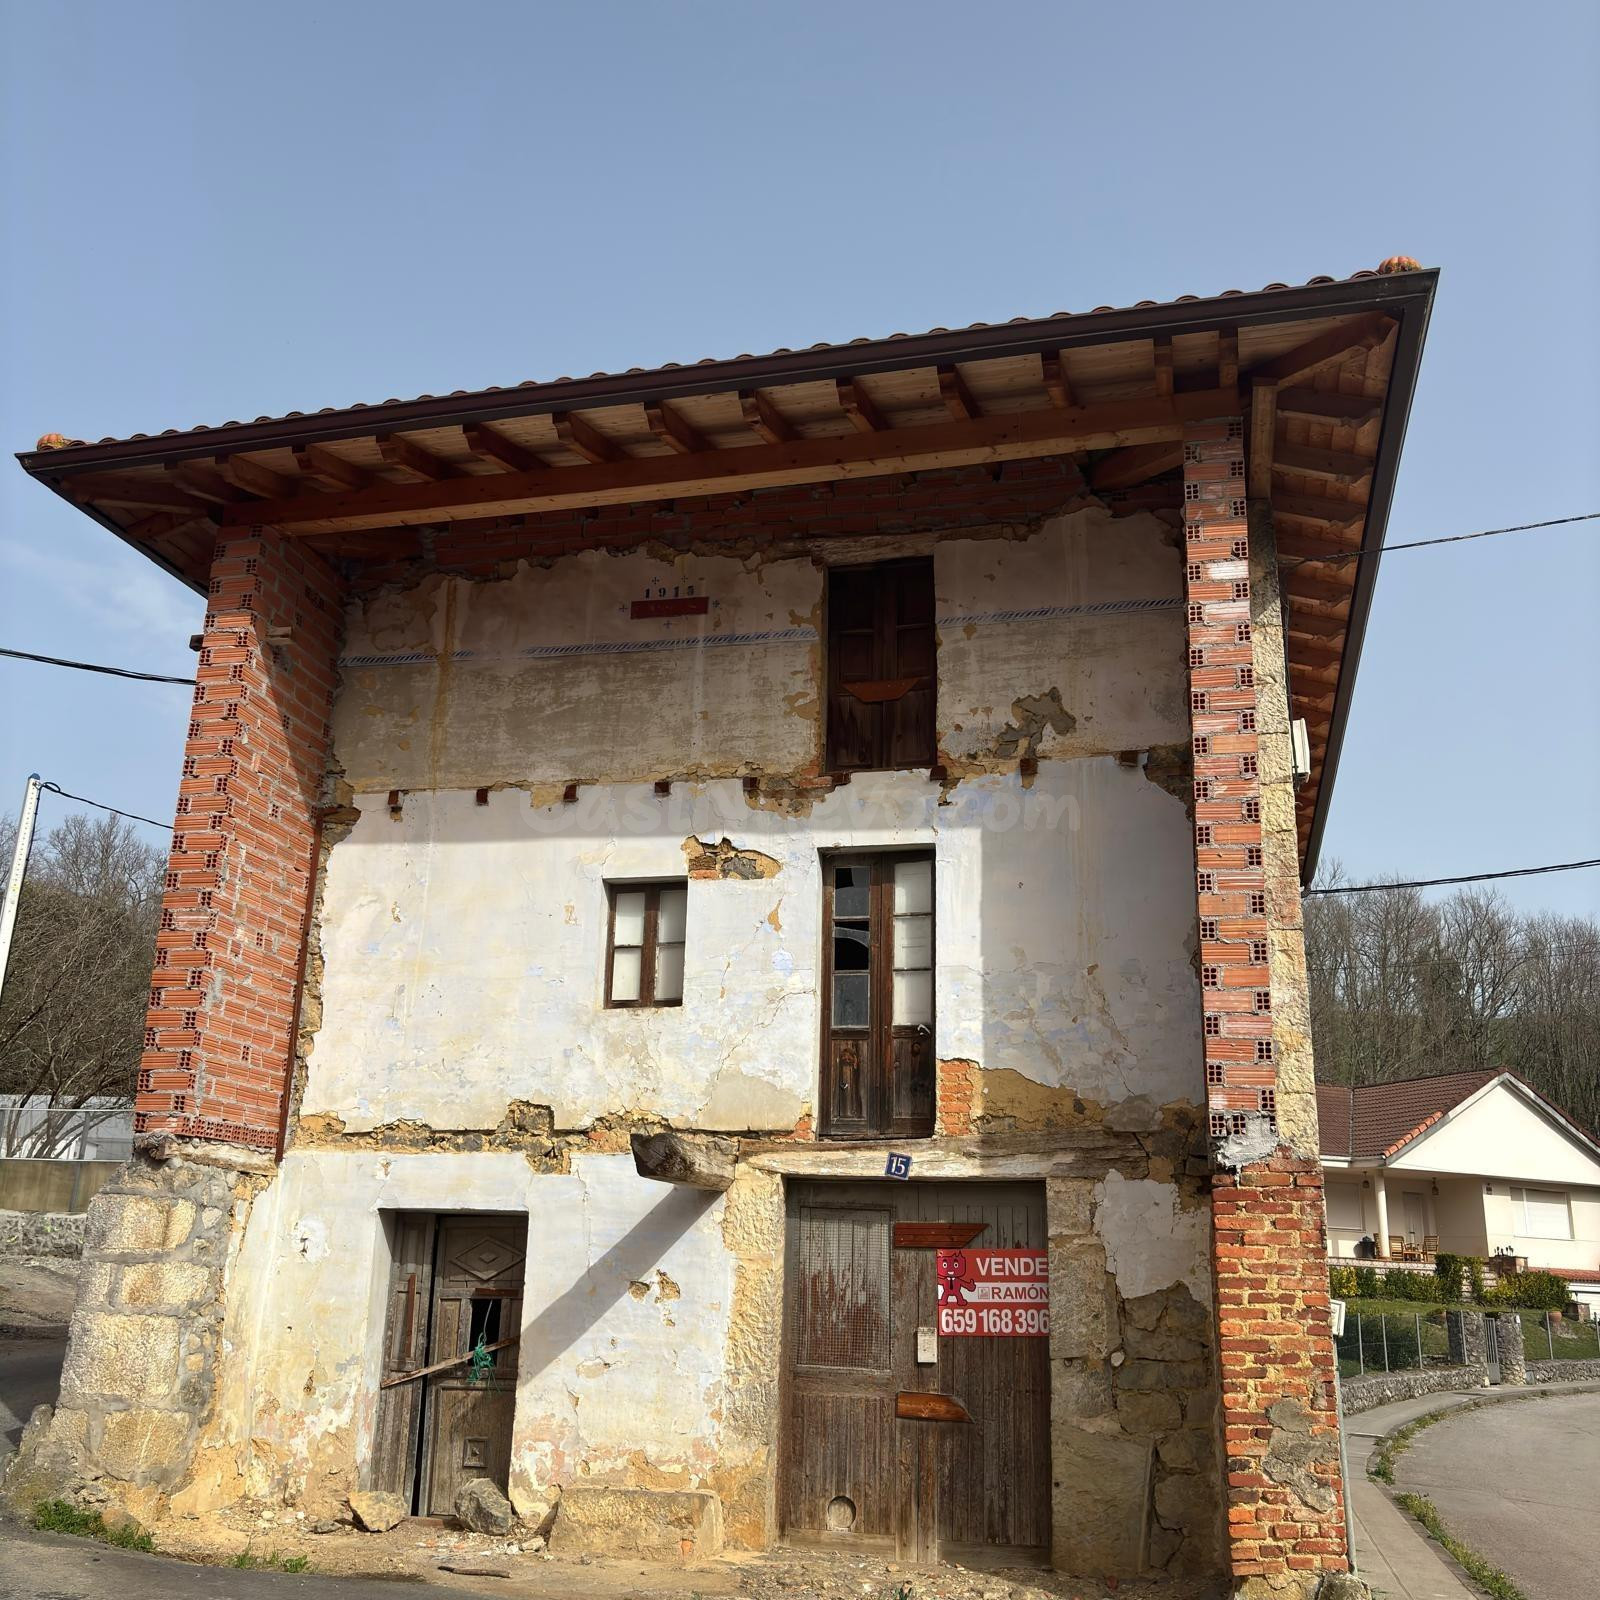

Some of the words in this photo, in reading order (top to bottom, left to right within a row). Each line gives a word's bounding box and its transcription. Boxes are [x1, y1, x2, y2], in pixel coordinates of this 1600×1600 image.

[890, 1156, 907, 1175] 15
[976, 1257, 1049, 1276] VENDE
[991, 1283, 1050, 1300] RAMÓN
[941, 1308, 977, 1334] 659
[979, 1308, 1013, 1334] 168
[1015, 1308, 1050, 1334] 396
